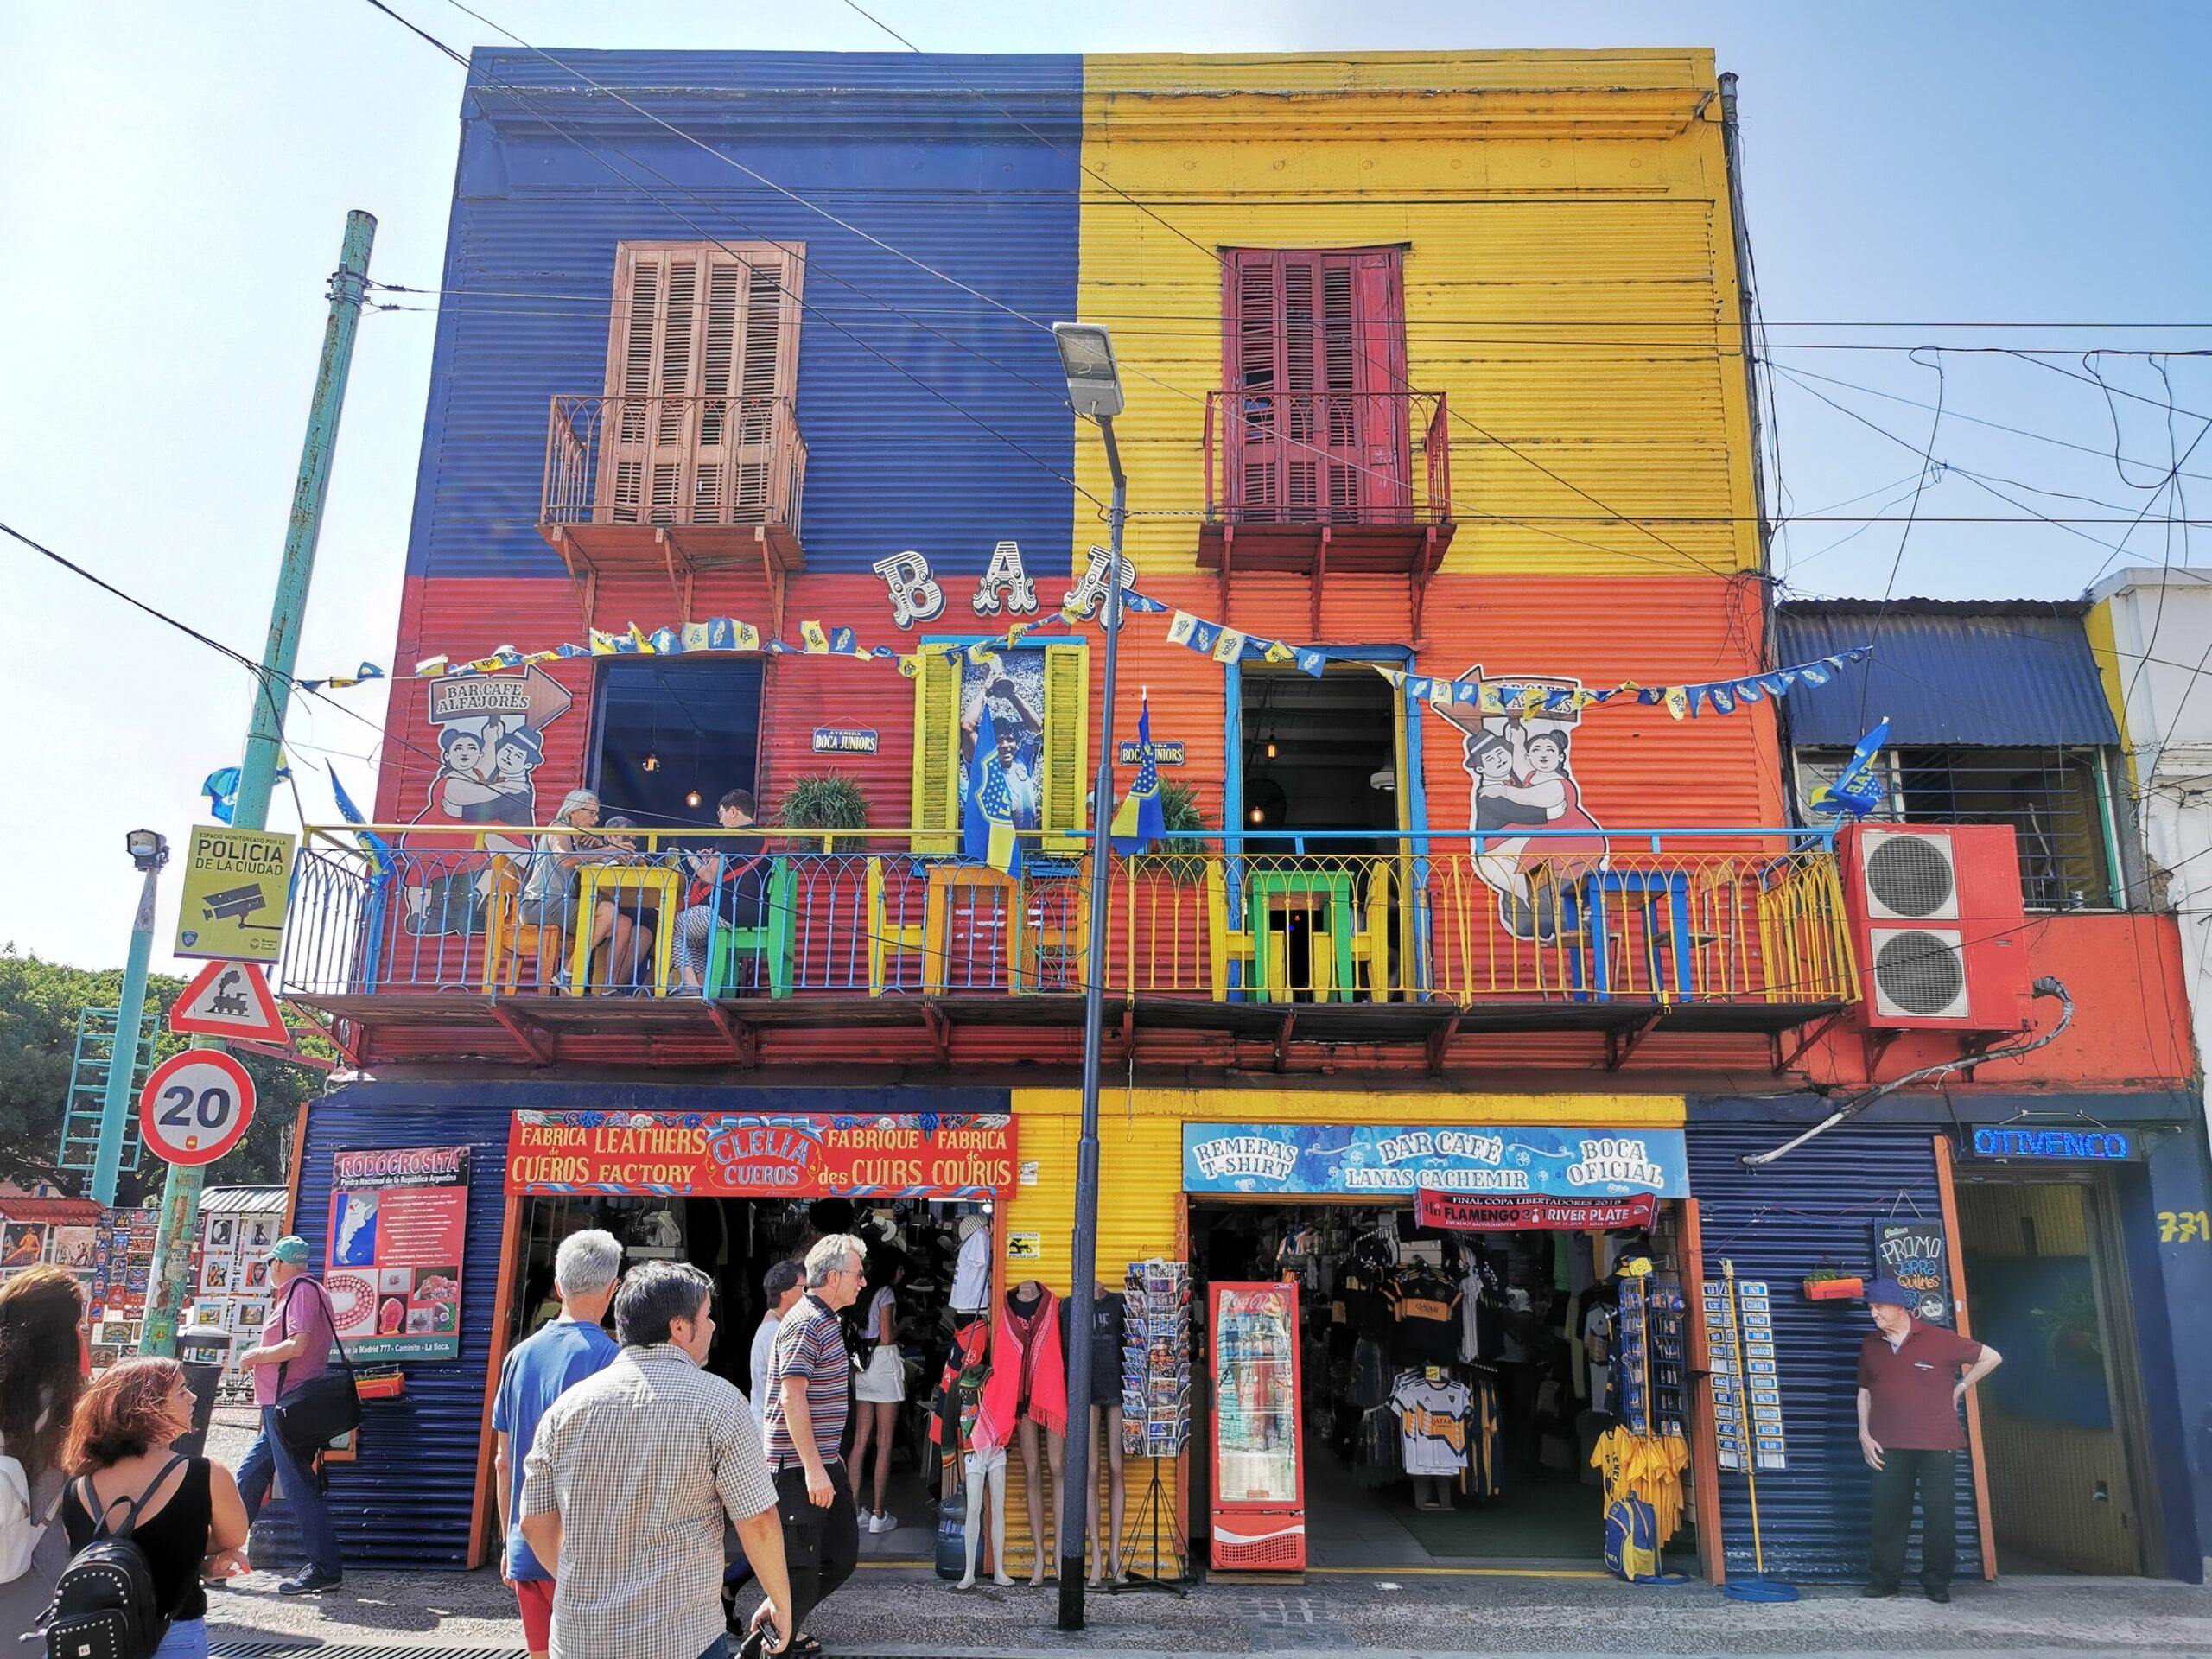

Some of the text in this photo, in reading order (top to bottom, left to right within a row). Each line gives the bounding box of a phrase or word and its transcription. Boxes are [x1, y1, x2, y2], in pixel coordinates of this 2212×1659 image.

[873, 542, 1137, 632] BAR
[447, 683, 522, 699] BAR CAFE
[438, 696, 528, 714] ALFAJORES
[815, 735, 875, 751] BOCA JUNIORS
[224, 835, 264, 843] MONITOREADO
[198, 839, 283, 863] POLICIA
[195, 857, 283, 875] DE LA CIUDAD
[159, 1086, 231, 1128] 20
[520, 1128, 588, 1147] FABRICA
[594, 1128, 707, 1154] LEATHERS
[712, 1129, 810, 1168] CLELIA
[827, 1128, 920, 1151] FABRIQUE
[937, 1129, 1008, 1153] FABRICA
[1381, 1131, 1503, 1164] BAR CAFÉ
[549, 1147, 560, 1156] de
[966, 1150, 979, 1161] de
[1196, 1138, 1298, 1163] REMERAS
[1581, 1140, 1645, 1160] BOCA
[340, 1152, 460, 1178] RODOCROSITA
[512, 1154, 590, 1184] CUEROS
[598, 1163, 697, 1184] FACTORY
[723, 1165, 800, 1186] CUEROS
[817, 1157, 923, 1188] des CUIRS
[931, 1157, 1012, 1187] COURUS
[1202, 1156, 1291, 1179] T-SHIRT
[1568, 1160, 1662, 1186] OFICIAL
[340, 1173, 457, 1186] Piedra Nacional de la República Argentina
[1347, 1169, 1528, 1189] LANAS CACHEMIR
[1452, 1196, 1483, 1205] FINAL
[1516, 1198, 1592, 1206] LIBERTADORES
[1444, 1206, 1520, 1222] FLAMENGO
[1522, 1209, 1531, 1221] 2
[1548, 1208, 1586, 1222] RIVER
[1590, 1208, 1630, 1221] PLATE
[2157, 1210, 2210, 1243] 771
[1879, 1236, 1941, 1265] PROMO
[352, 1345, 359, 1354] la
[359, 1344, 378, 1354] Madrid
[380, 1344, 391, 1352] 777
[395, 1343, 421, 1352] Caminito
[433, 1342, 450, 1351] Boca.
